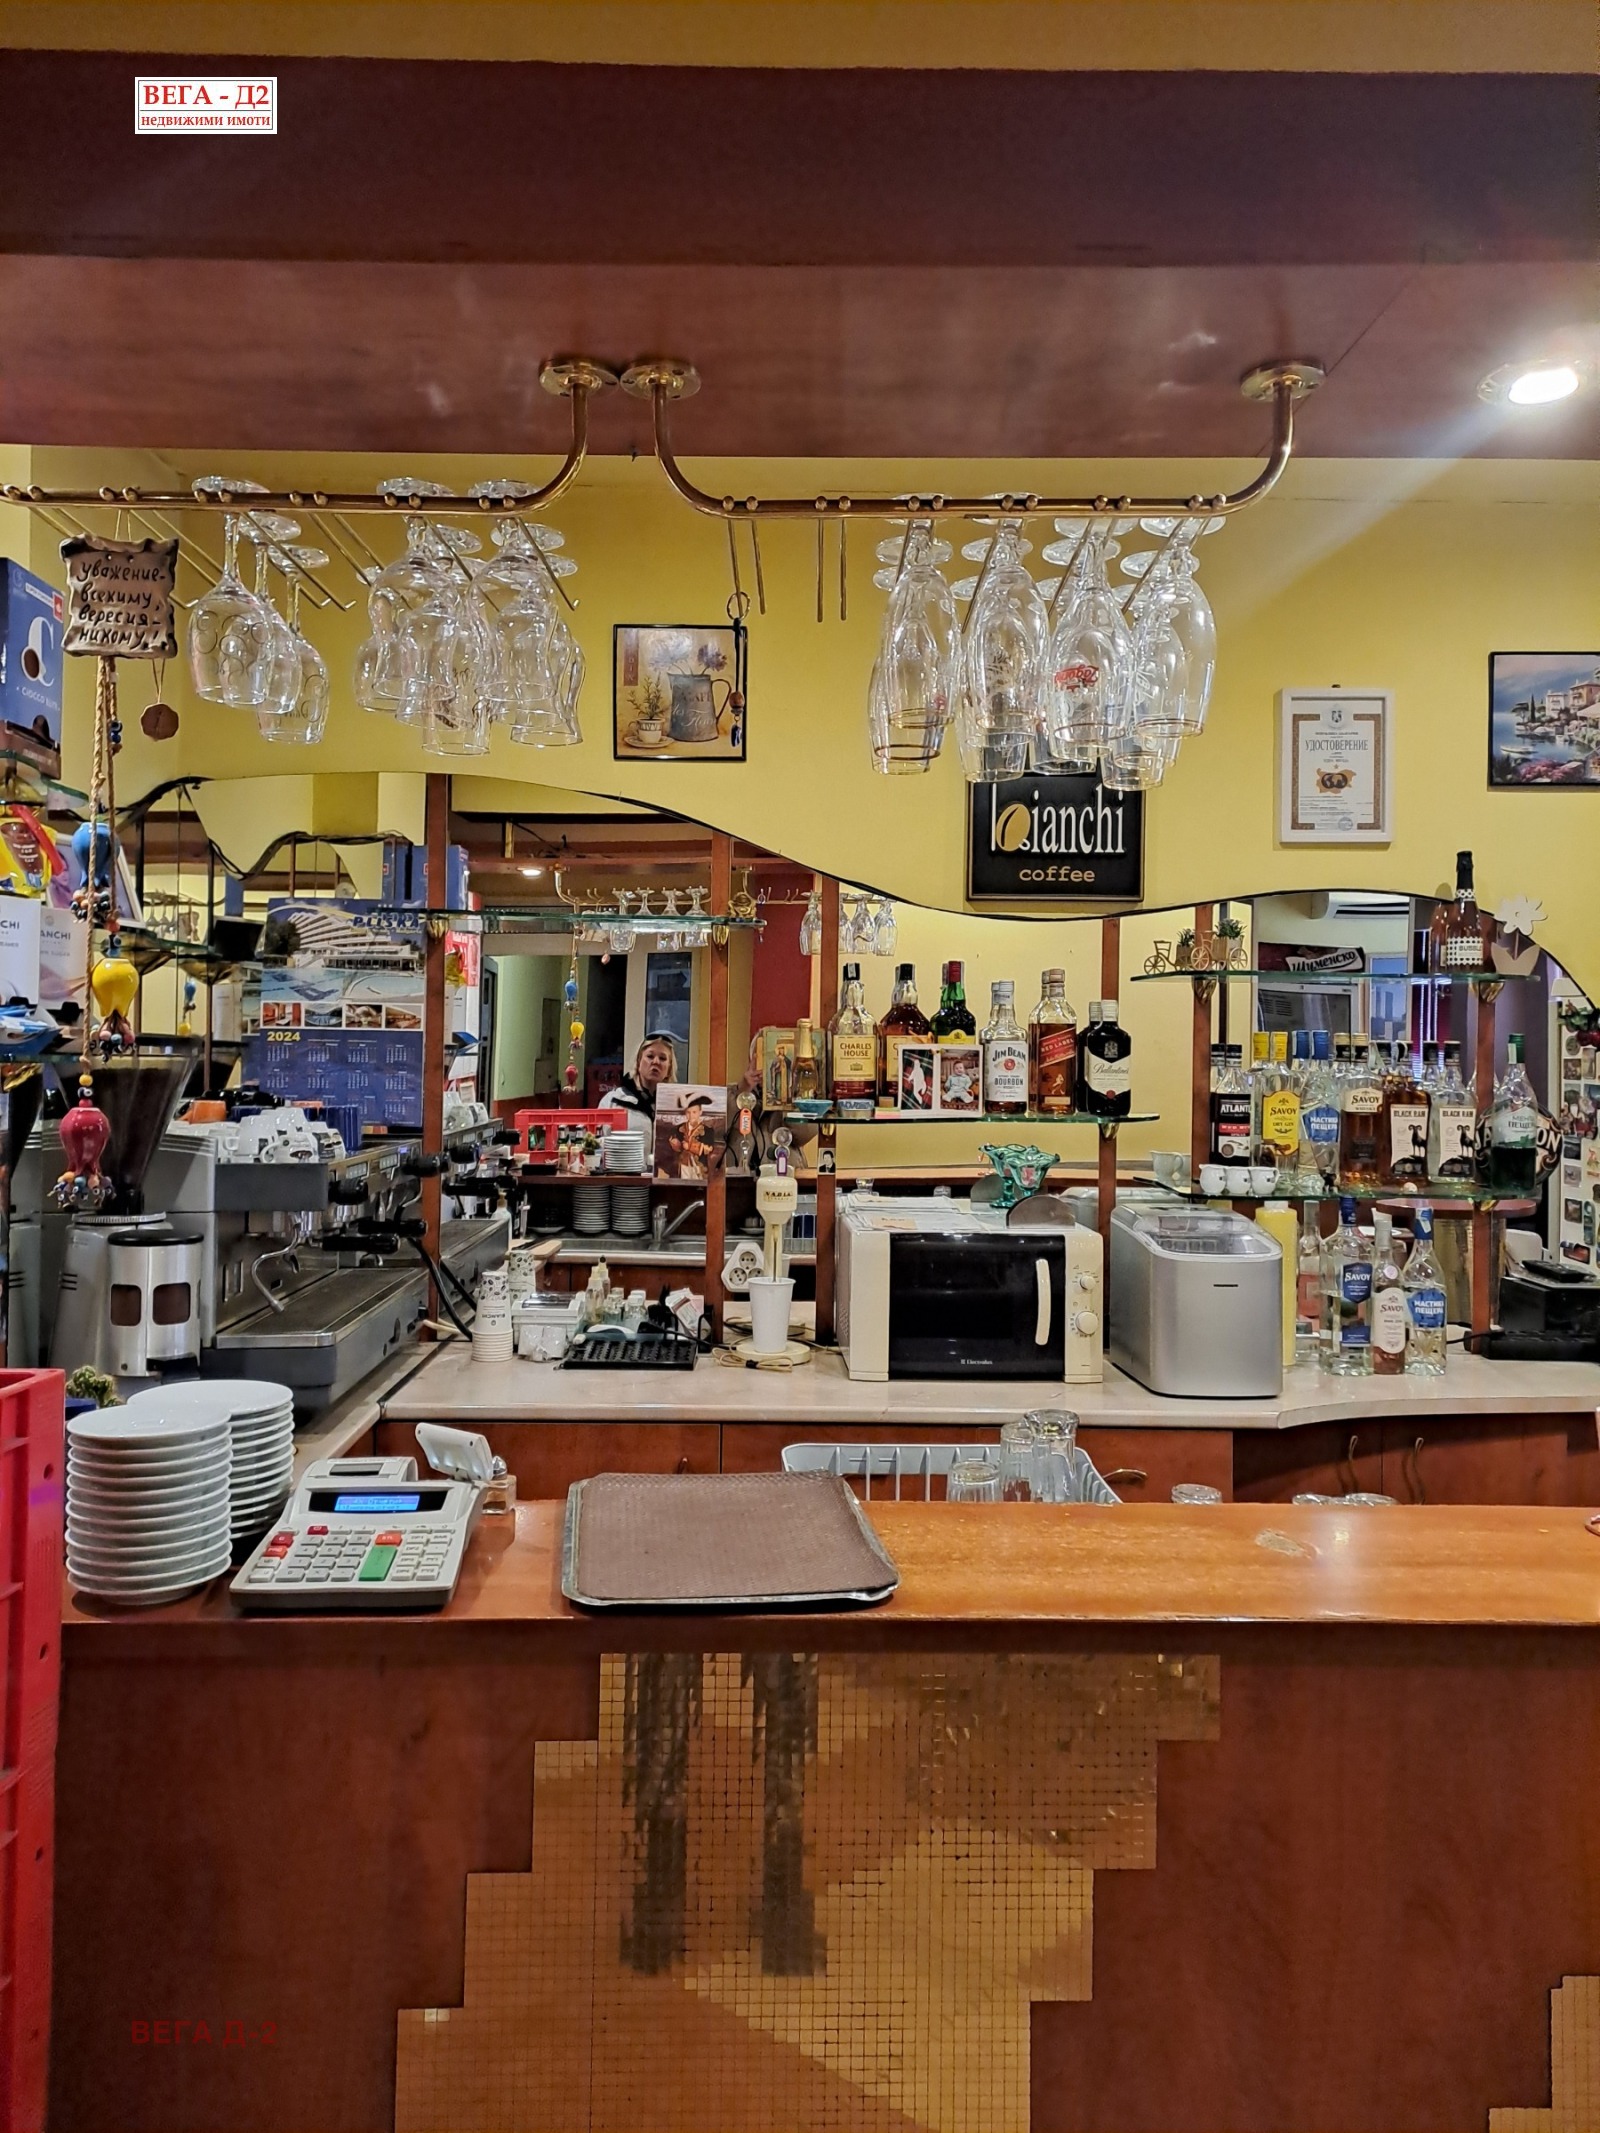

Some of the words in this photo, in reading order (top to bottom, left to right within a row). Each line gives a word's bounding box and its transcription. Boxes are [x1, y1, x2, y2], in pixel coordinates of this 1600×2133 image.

[1305, 740, 1368, 752] УДОСТОВЕРЕНИЕ
[1019, 866, 1096, 882] coffee
[267, 1031, 300, 1042] 2024
[1041, 1044, 1054, 1053] RED
[1054, 1038, 1075, 1048] LABEL
[992, 1050, 1007, 1062] JIM
[1007, 1047, 1026, 1061] BEAM
[994, 1078, 1024, 1086] BOURBON
[1351, 1095, 1380, 1104] SAVOY
[1220, 1104, 1250, 1114] ATLANT
[1270, 1107, 1298, 1116] SAVOY
[1345, 1272, 1371, 1282] SAVOY
